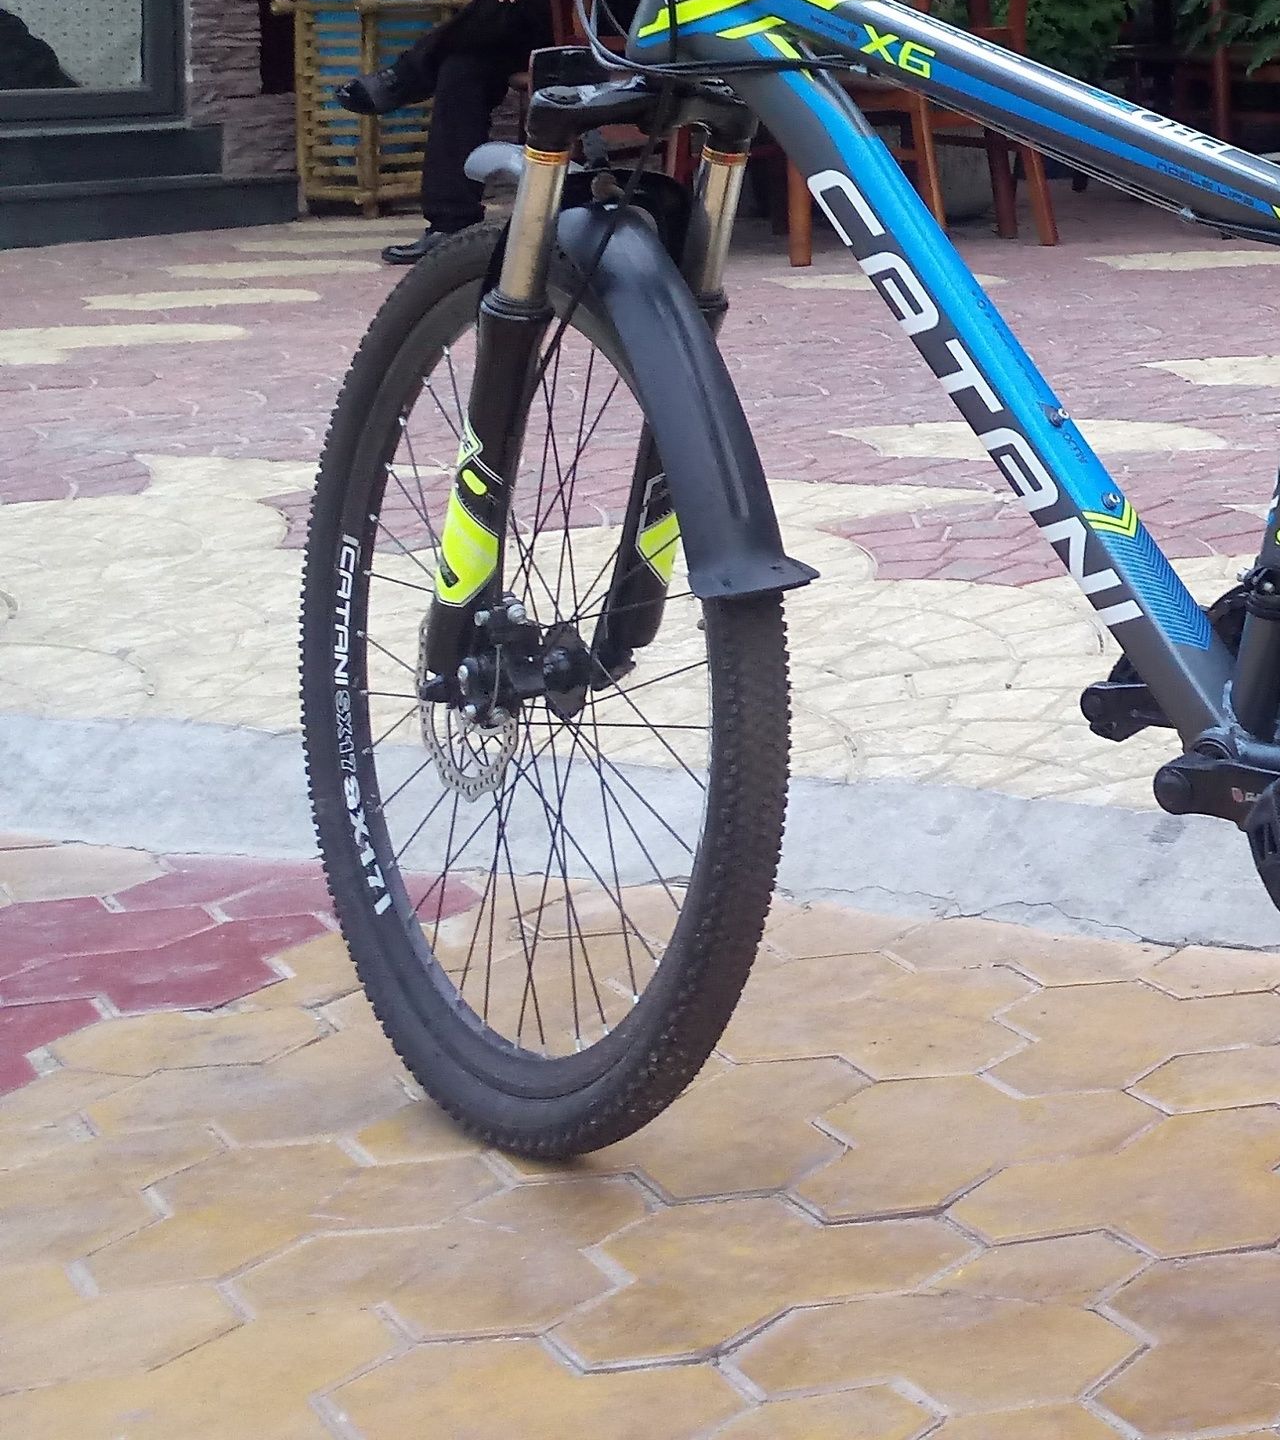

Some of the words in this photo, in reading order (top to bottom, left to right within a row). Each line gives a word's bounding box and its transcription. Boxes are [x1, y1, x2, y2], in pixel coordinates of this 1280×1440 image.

[860, 23, 937, 80] X6
[806, 169, 1145, 627] CATANI
[333, 546, 357, 686] CATANI
